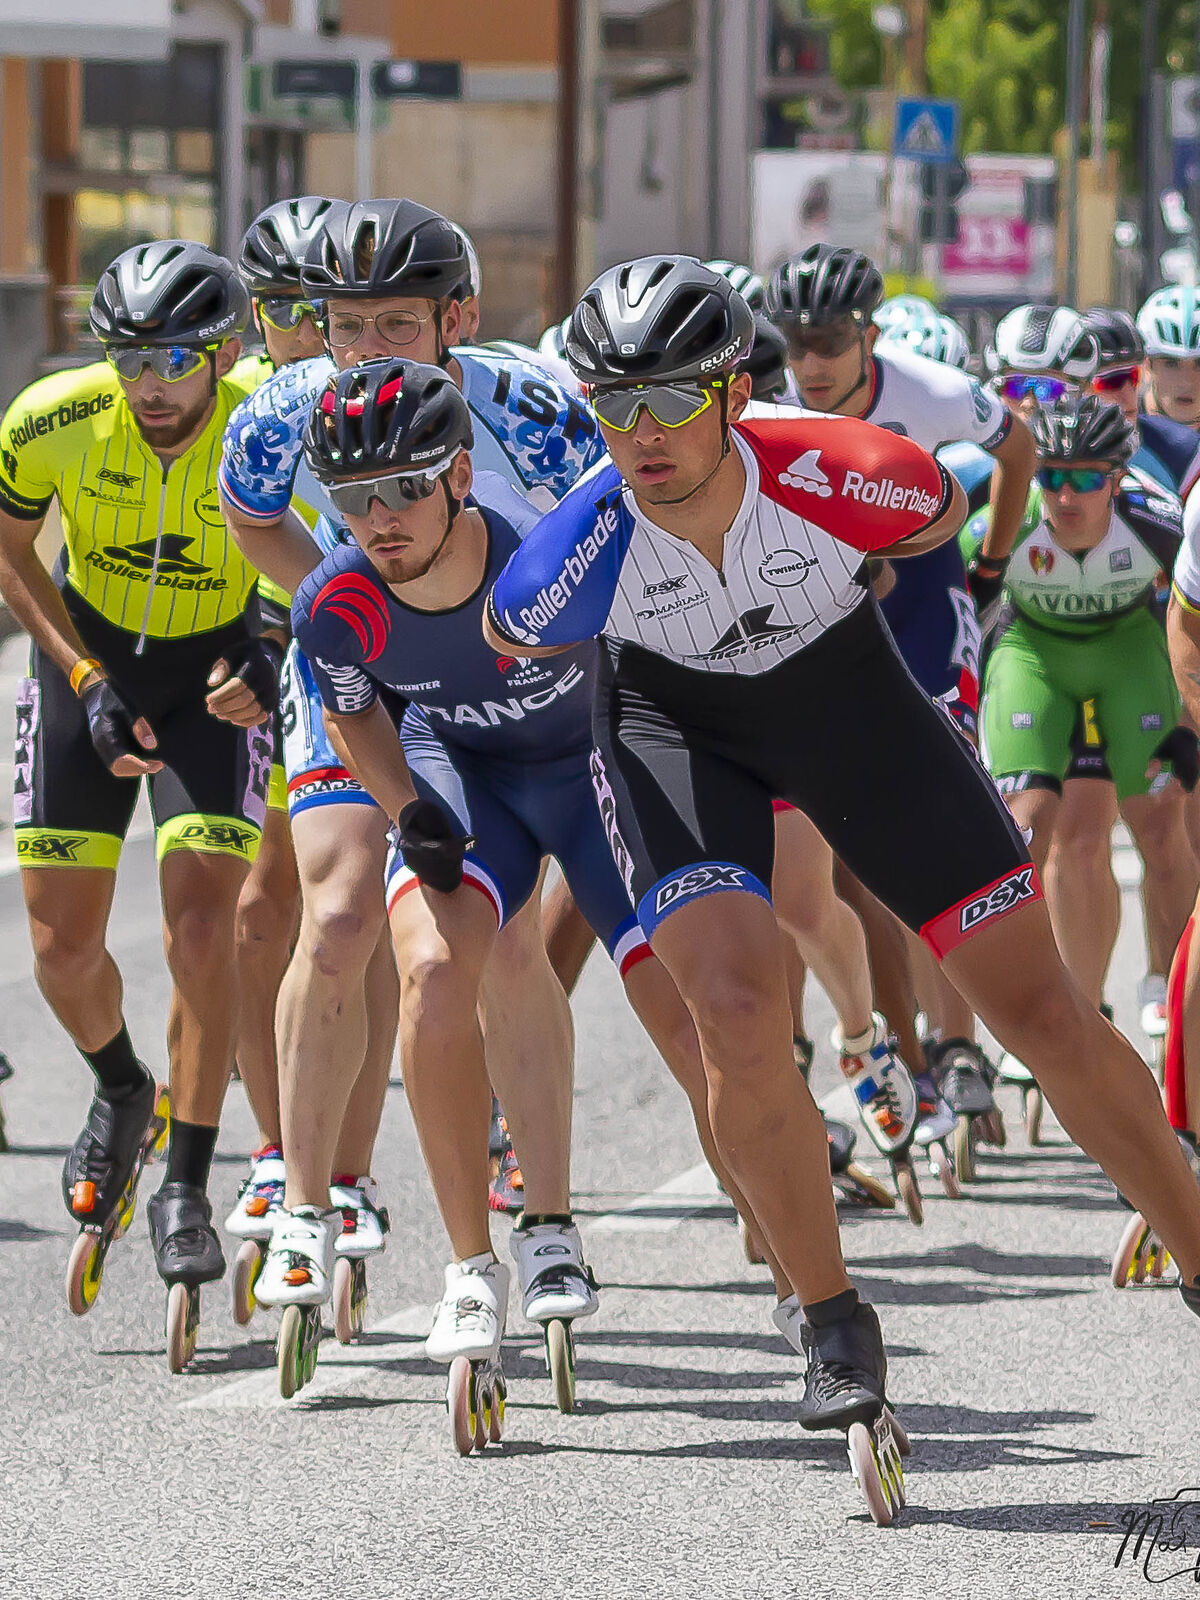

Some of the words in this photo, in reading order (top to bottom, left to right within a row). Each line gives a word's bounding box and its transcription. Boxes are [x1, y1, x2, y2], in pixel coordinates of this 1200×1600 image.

[198, 312, 235, 337] RUDY
[701, 336, 741, 371] RUDY
[8, 391, 115, 453] Rollerblade
[840, 470, 940, 519] Rollerblade
[84, 551, 229, 592] Rollerblade
[519, 506, 619, 635] Rollerblade
[767, 557, 820, 577] TWINCAM
[643, 574, 689, 599] DSX
[655, 590, 710, 614] MARIANI
[419, 662, 585, 728] RANCE
[507, 671, 554, 687] FRANCE
[16, 835, 88, 862] DSX
[176, 824, 258, 854] DSX
[656, 865, 746, 915] DSX
[959, 867, 1036, 933] DSX
